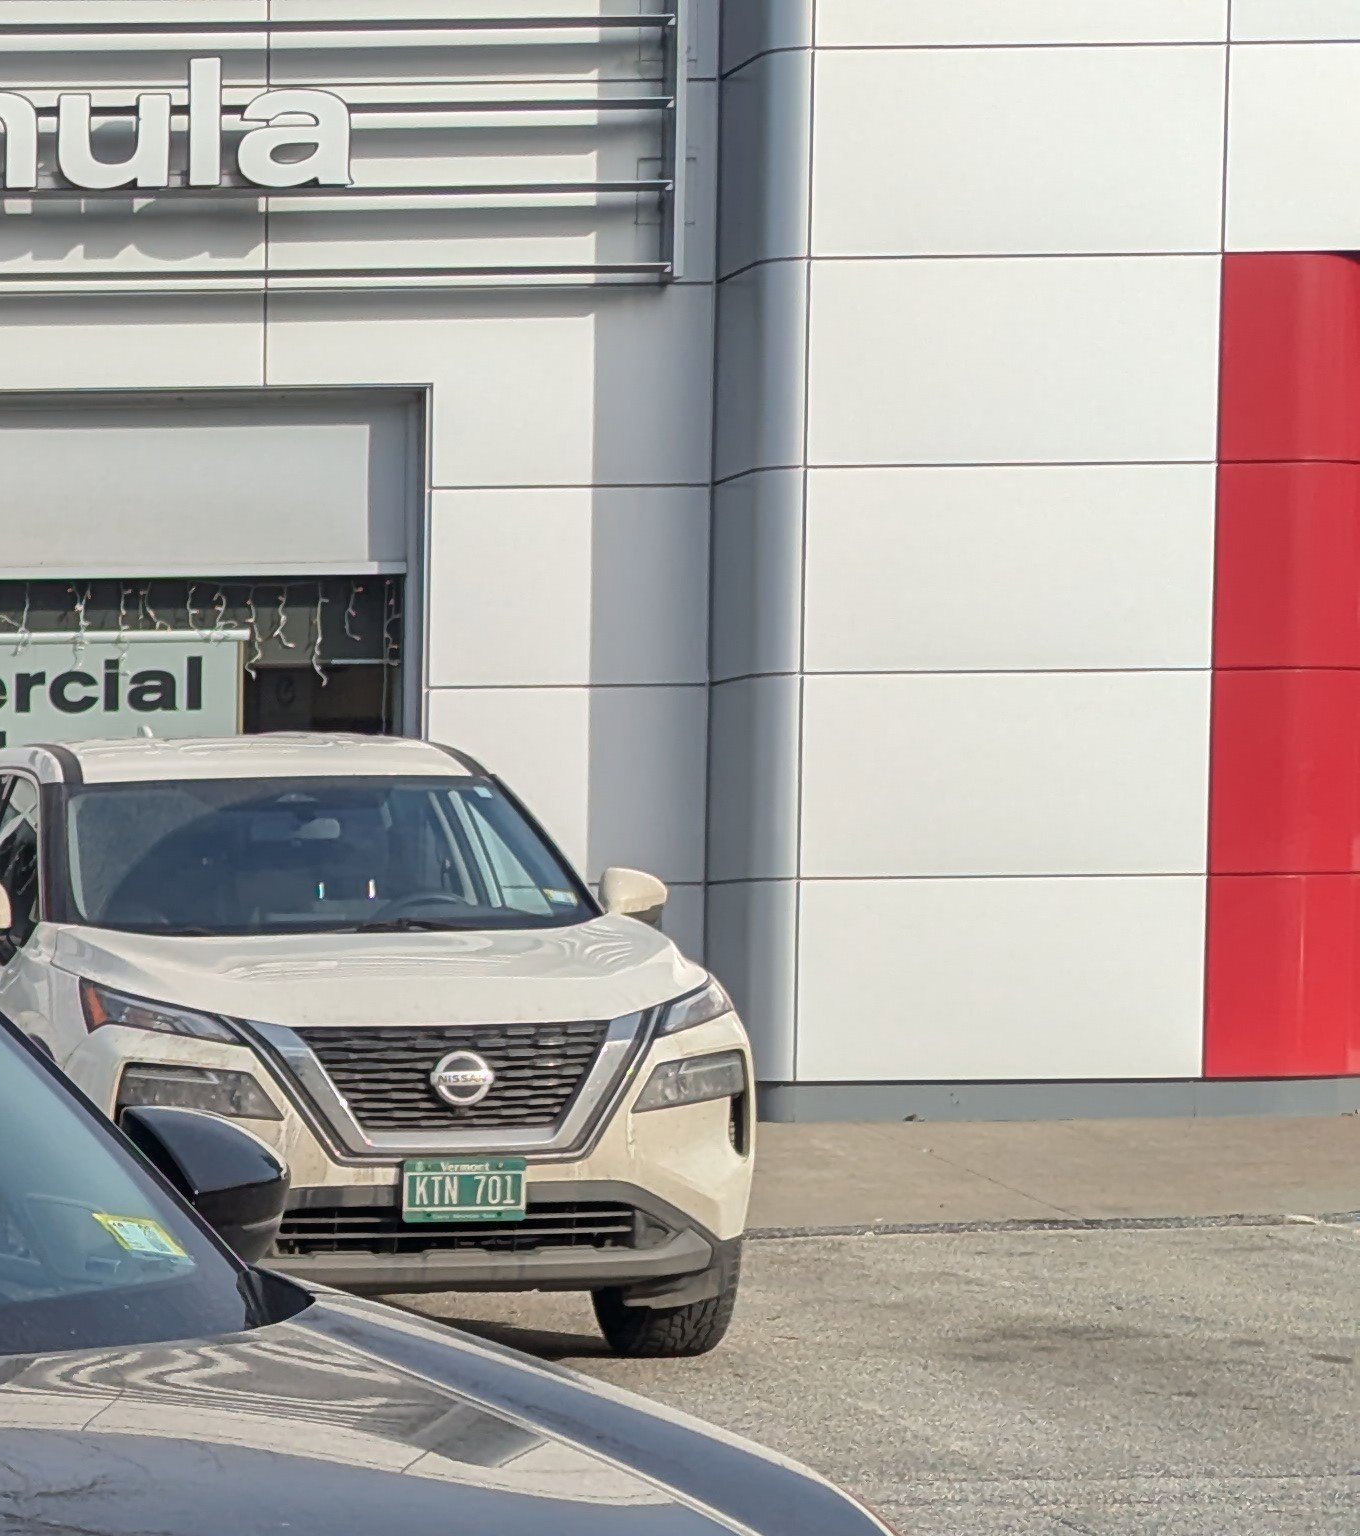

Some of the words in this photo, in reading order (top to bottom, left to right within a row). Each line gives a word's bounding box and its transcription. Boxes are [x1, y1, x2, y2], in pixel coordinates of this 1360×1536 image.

[438, 1074, 488, 1085] NISSAN
[440, 1161, 490, 1172] Vermont
[415, 1175, 458, 1206] KTN
[473, 1175, 516, 1205] 701
